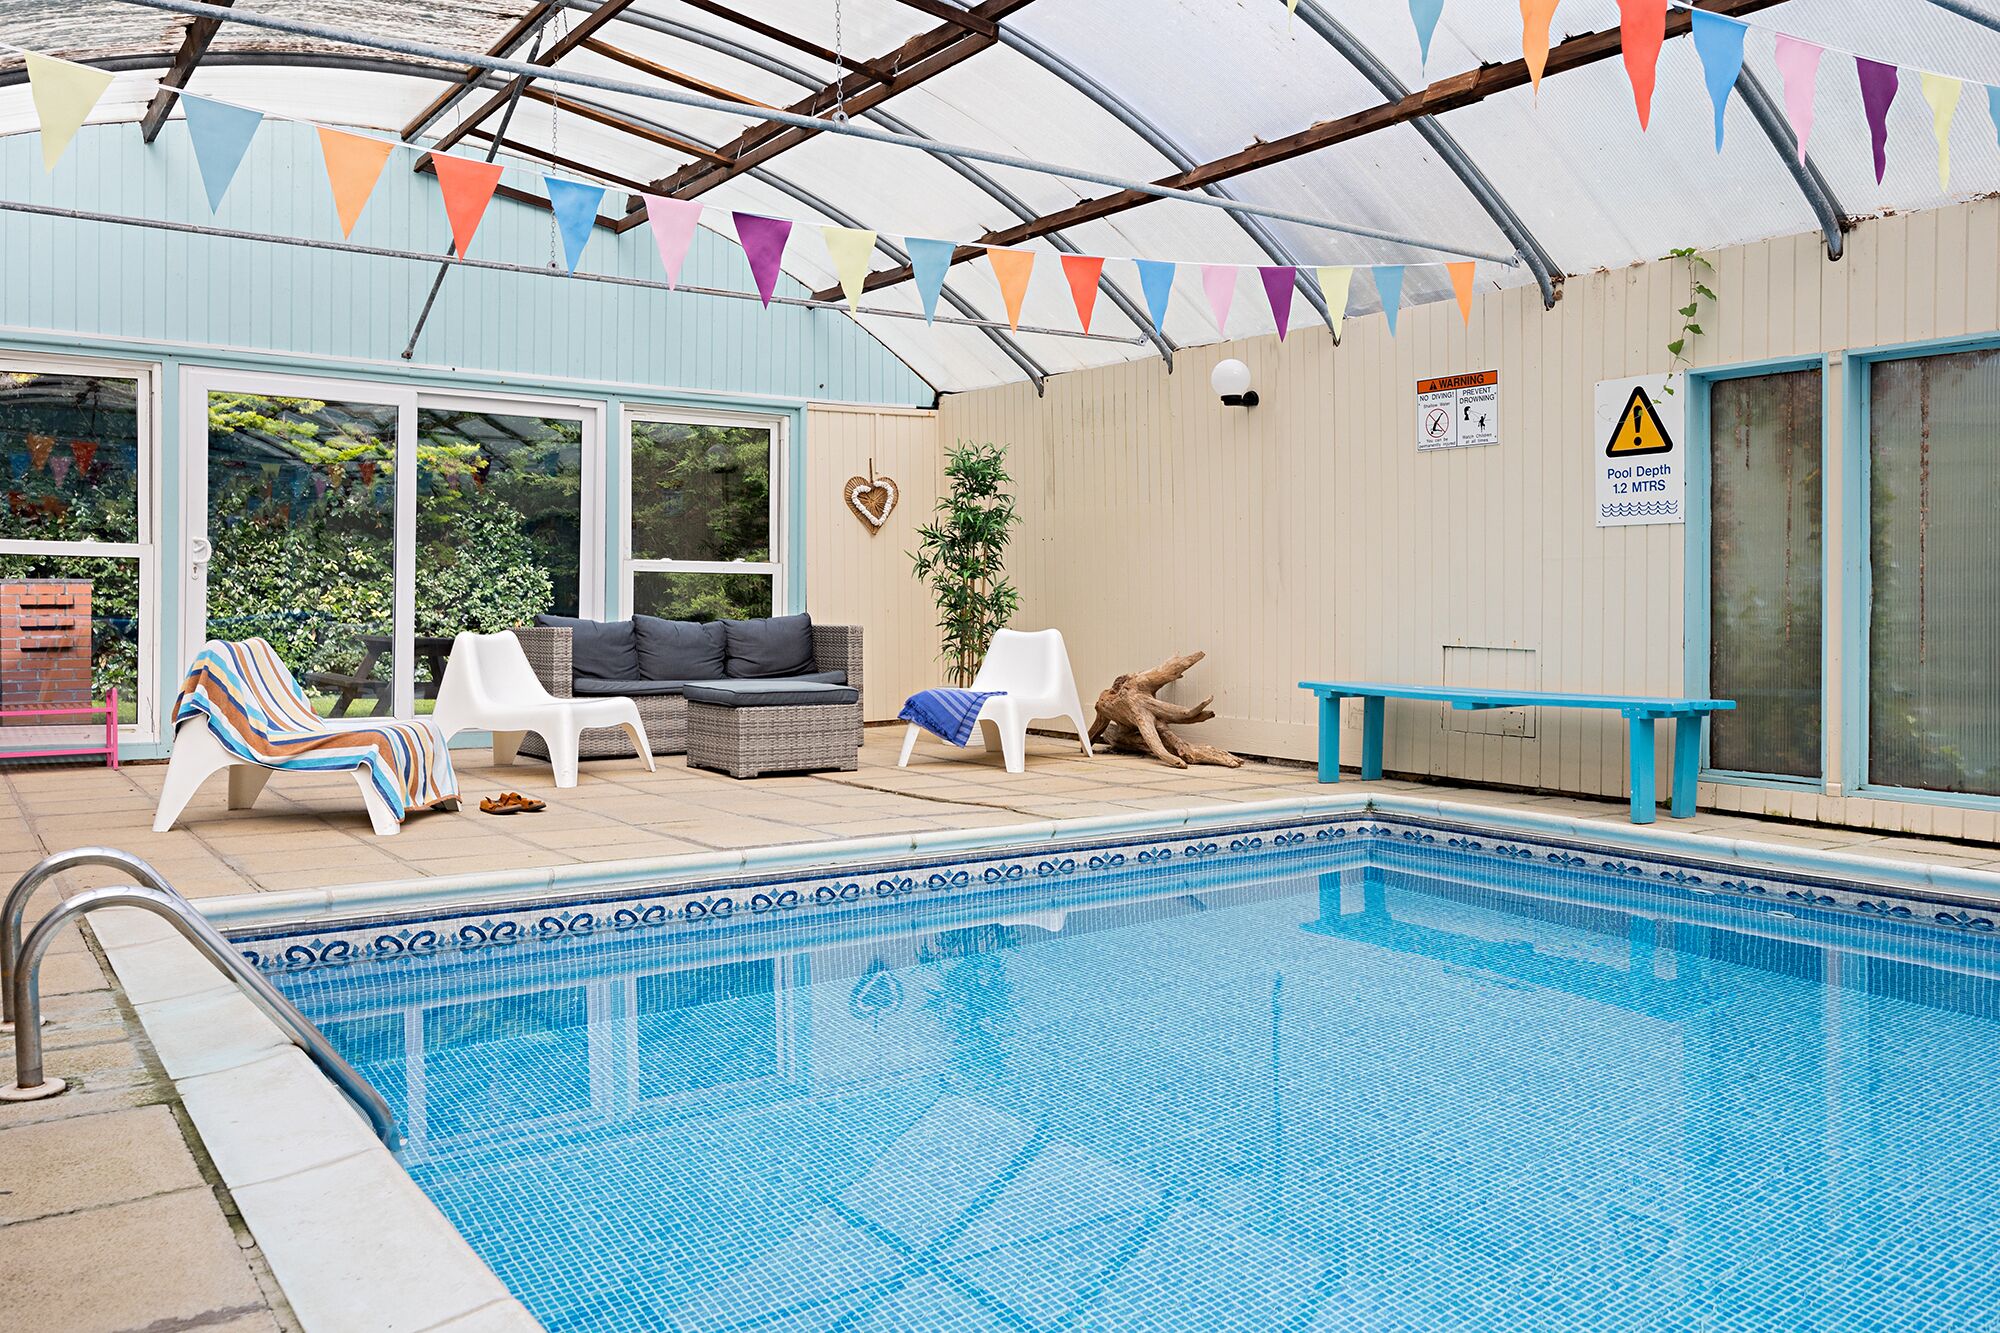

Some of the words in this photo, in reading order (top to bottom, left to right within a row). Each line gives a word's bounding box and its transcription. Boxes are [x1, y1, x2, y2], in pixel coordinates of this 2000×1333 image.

[1439, 374, 1484, 388] WARNING
[1432, 392, 1454, 400] DIVING!
[1463, 387, 1491, 396] PREVENT
[1460, 394, 1494, 404] DROWNING
[1607, 467, 1632, 479] Pool
[1637, 464, 1671, 478] Depth
[1613, 483, 1627, 494] 1.2
[1632, 480, 1665, 492] MTRS
